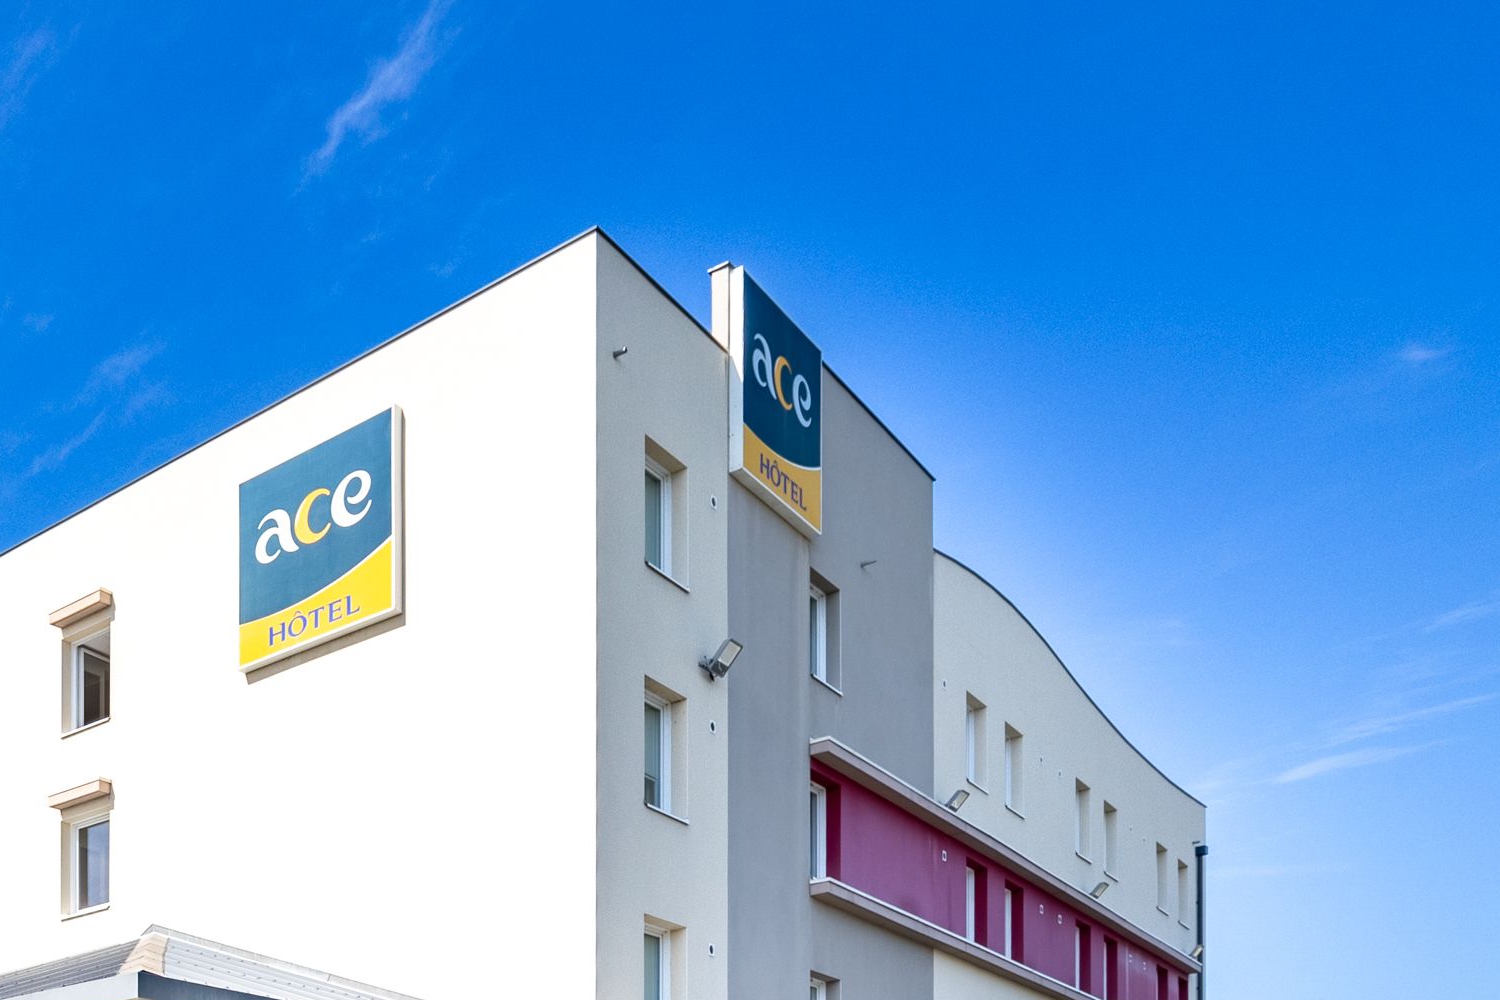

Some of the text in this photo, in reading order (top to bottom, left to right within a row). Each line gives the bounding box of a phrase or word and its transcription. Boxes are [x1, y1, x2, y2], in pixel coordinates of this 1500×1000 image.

[752, 333, 812, 428] ace
[255, 469, 372, 564] ace
[760, 453, 808, 511] HÔTEL
[268, 595, 360, 646] HÔTEL
